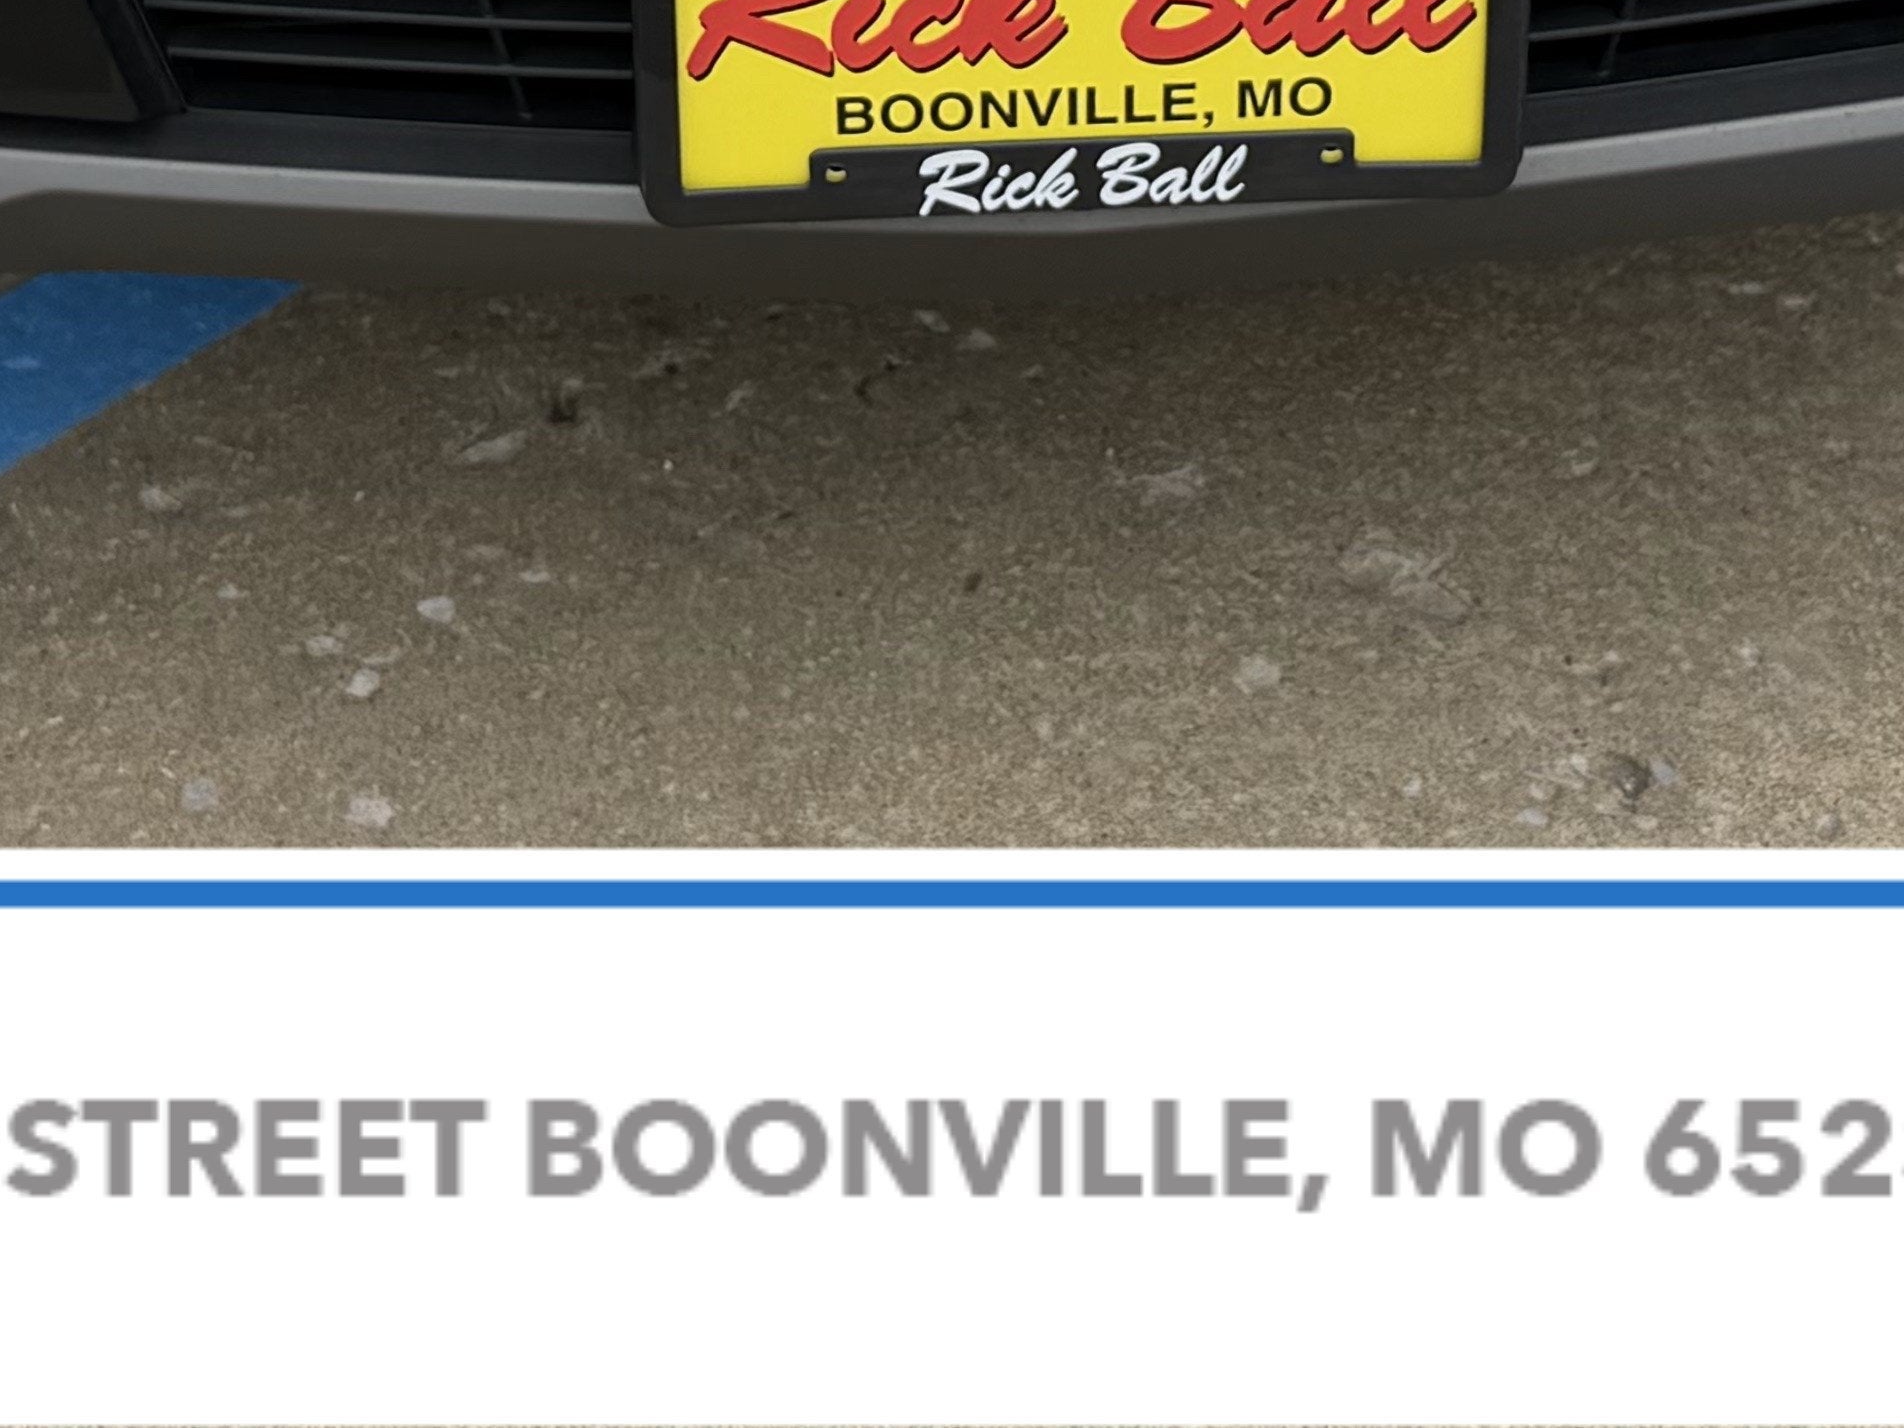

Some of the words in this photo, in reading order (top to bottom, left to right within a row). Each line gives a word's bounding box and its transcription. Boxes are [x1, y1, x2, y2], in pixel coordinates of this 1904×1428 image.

[835, 81, 1216, 136] BOONVILLE,
[1237, 76, 1334, 118] MO
[918, 146, 1080, 217] Rick
[1096, 142, 1248, 206] Ball
